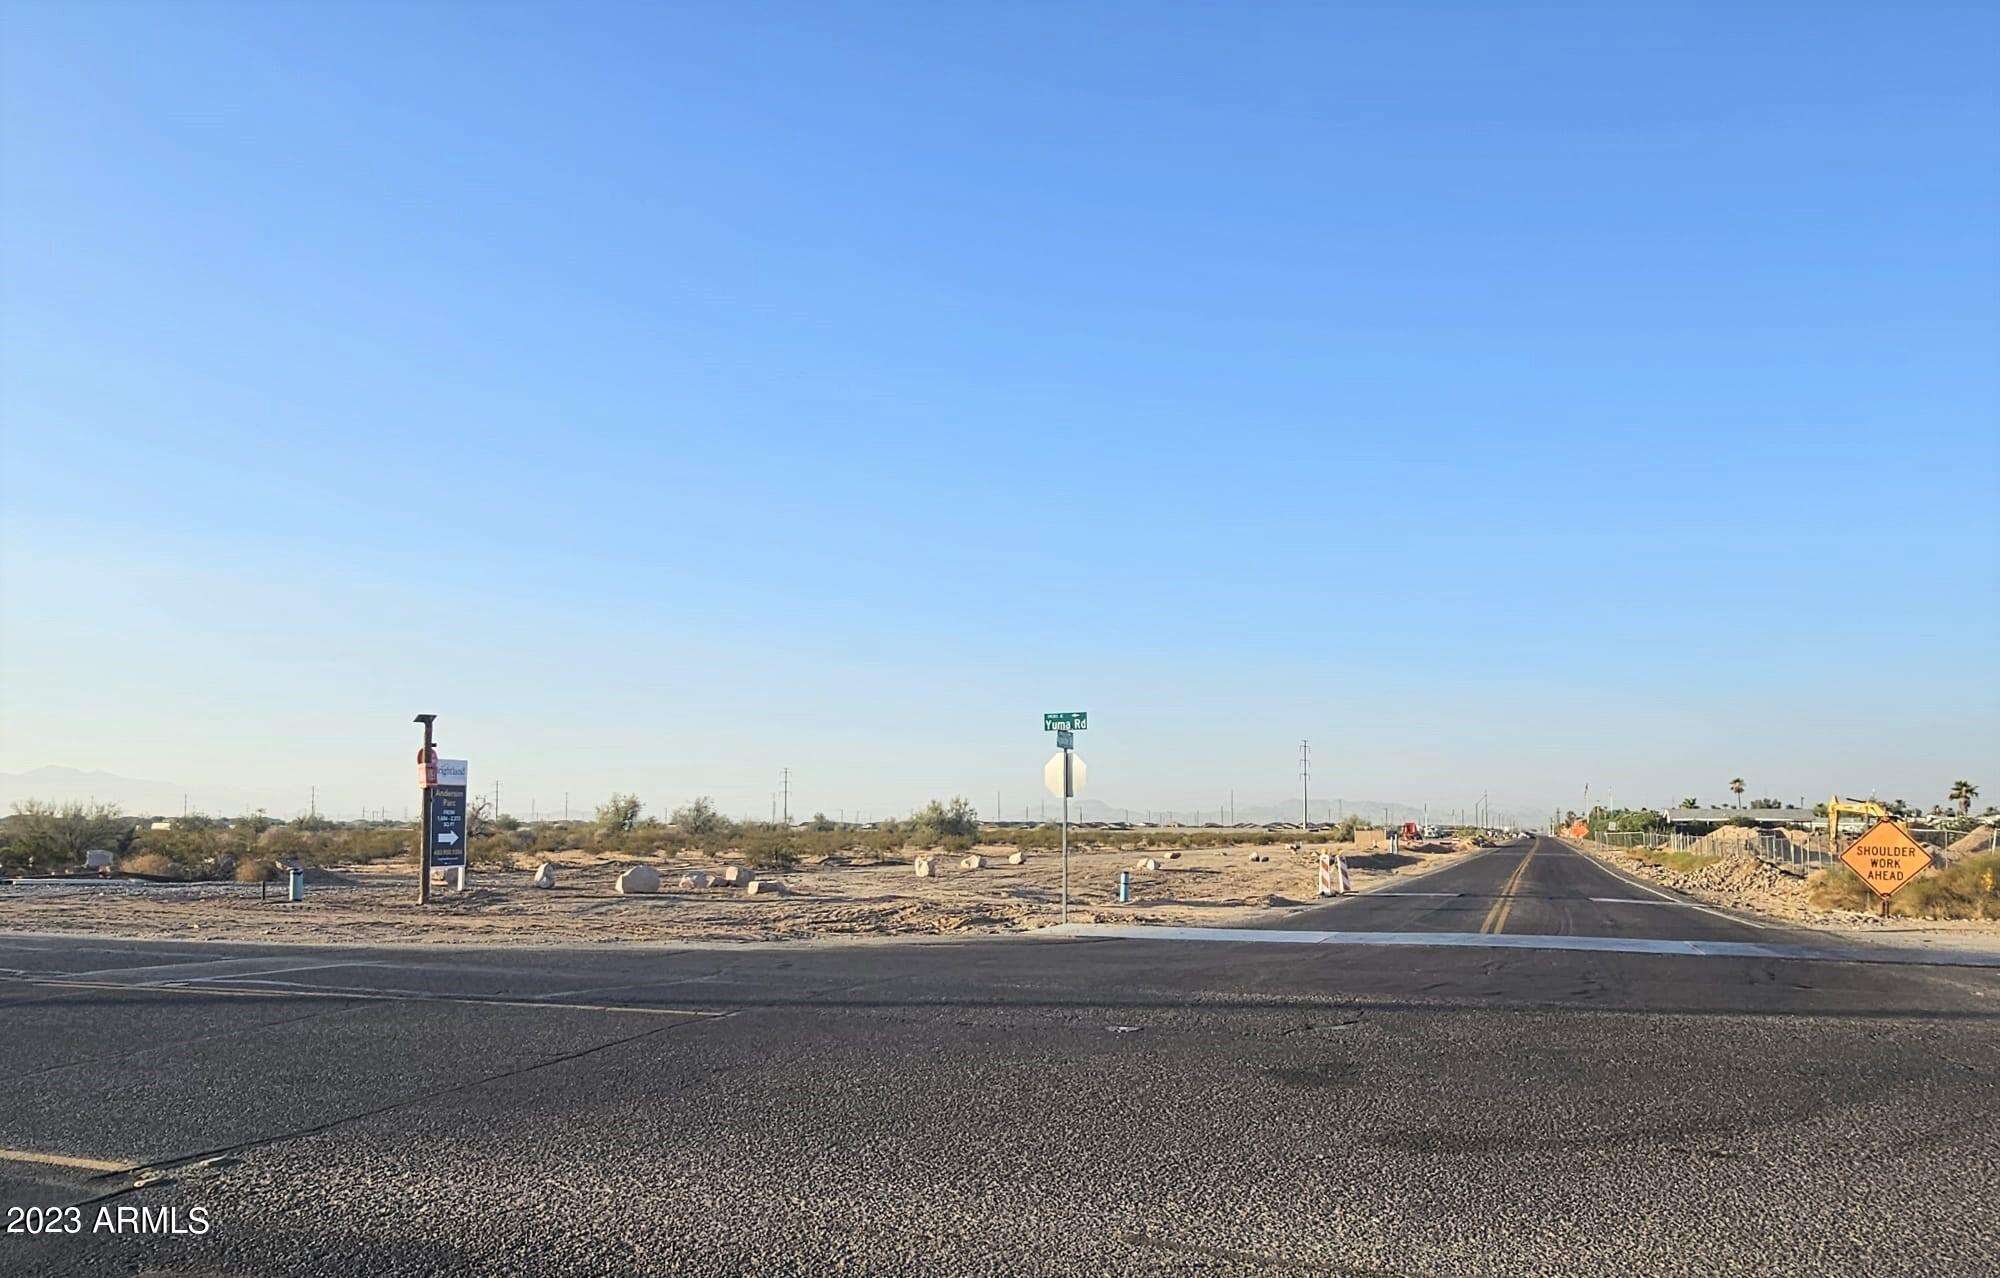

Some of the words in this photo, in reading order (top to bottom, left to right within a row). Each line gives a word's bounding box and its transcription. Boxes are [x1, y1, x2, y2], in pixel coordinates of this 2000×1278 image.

[1045, 719, 1071, 730] Yuma
[1074, 718, 1087, 729] Rd
[1856, 845, 1916, 857] SHOULDER
[1870, 858, 1901, 869] WORK
[1867, 870, 1904, 881] AHEAD
